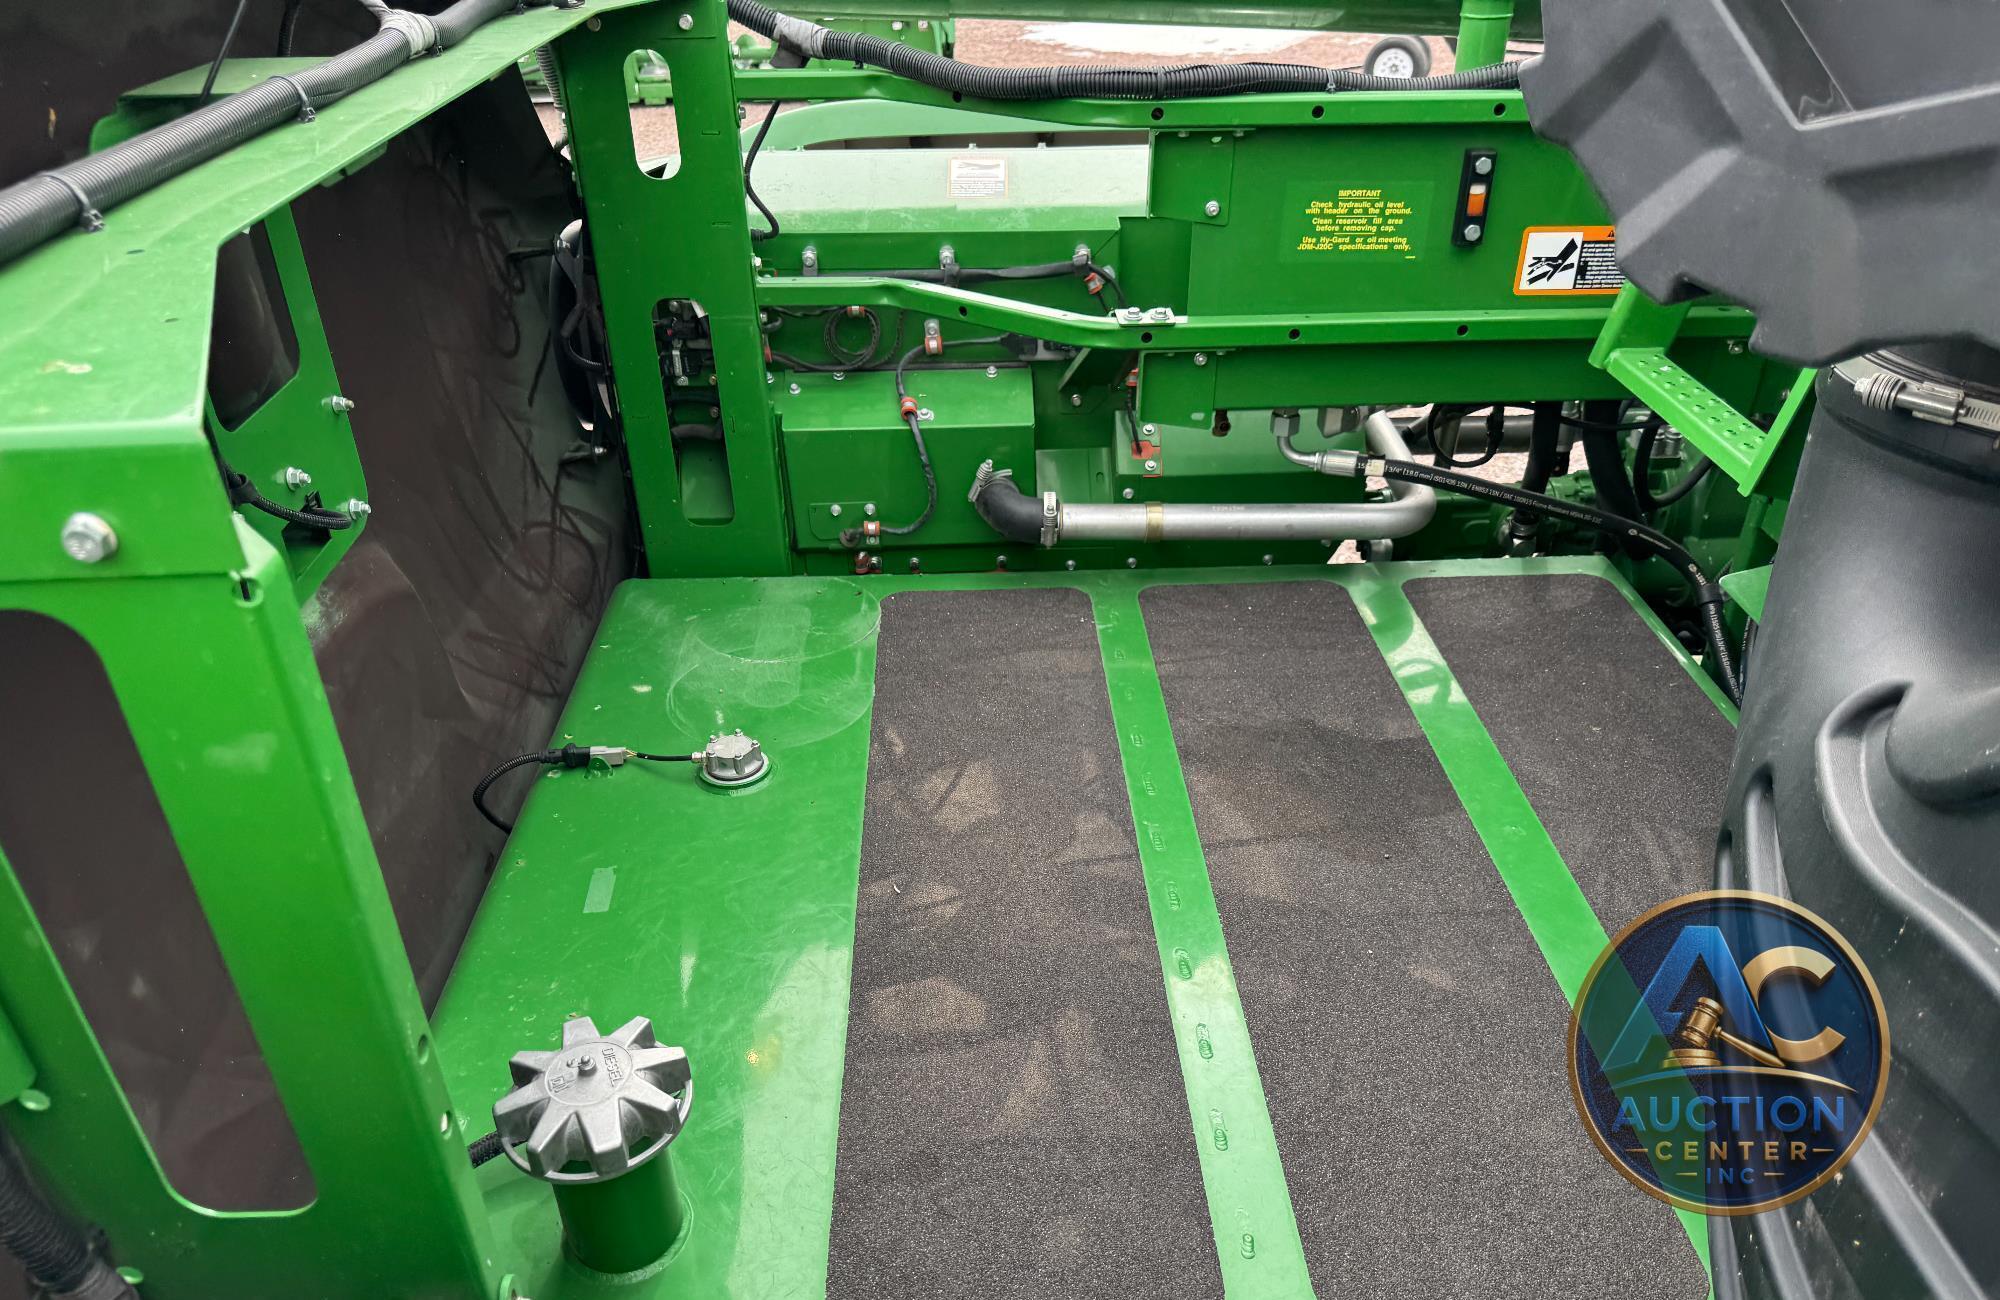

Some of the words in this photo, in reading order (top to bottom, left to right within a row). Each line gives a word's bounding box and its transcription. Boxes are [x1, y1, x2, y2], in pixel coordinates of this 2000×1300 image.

[1338, 201, 1371, 209] hydraulic
[1339, 243, 1388, 251] specifications
[602, 1047, 624, 1087] DIESEL
